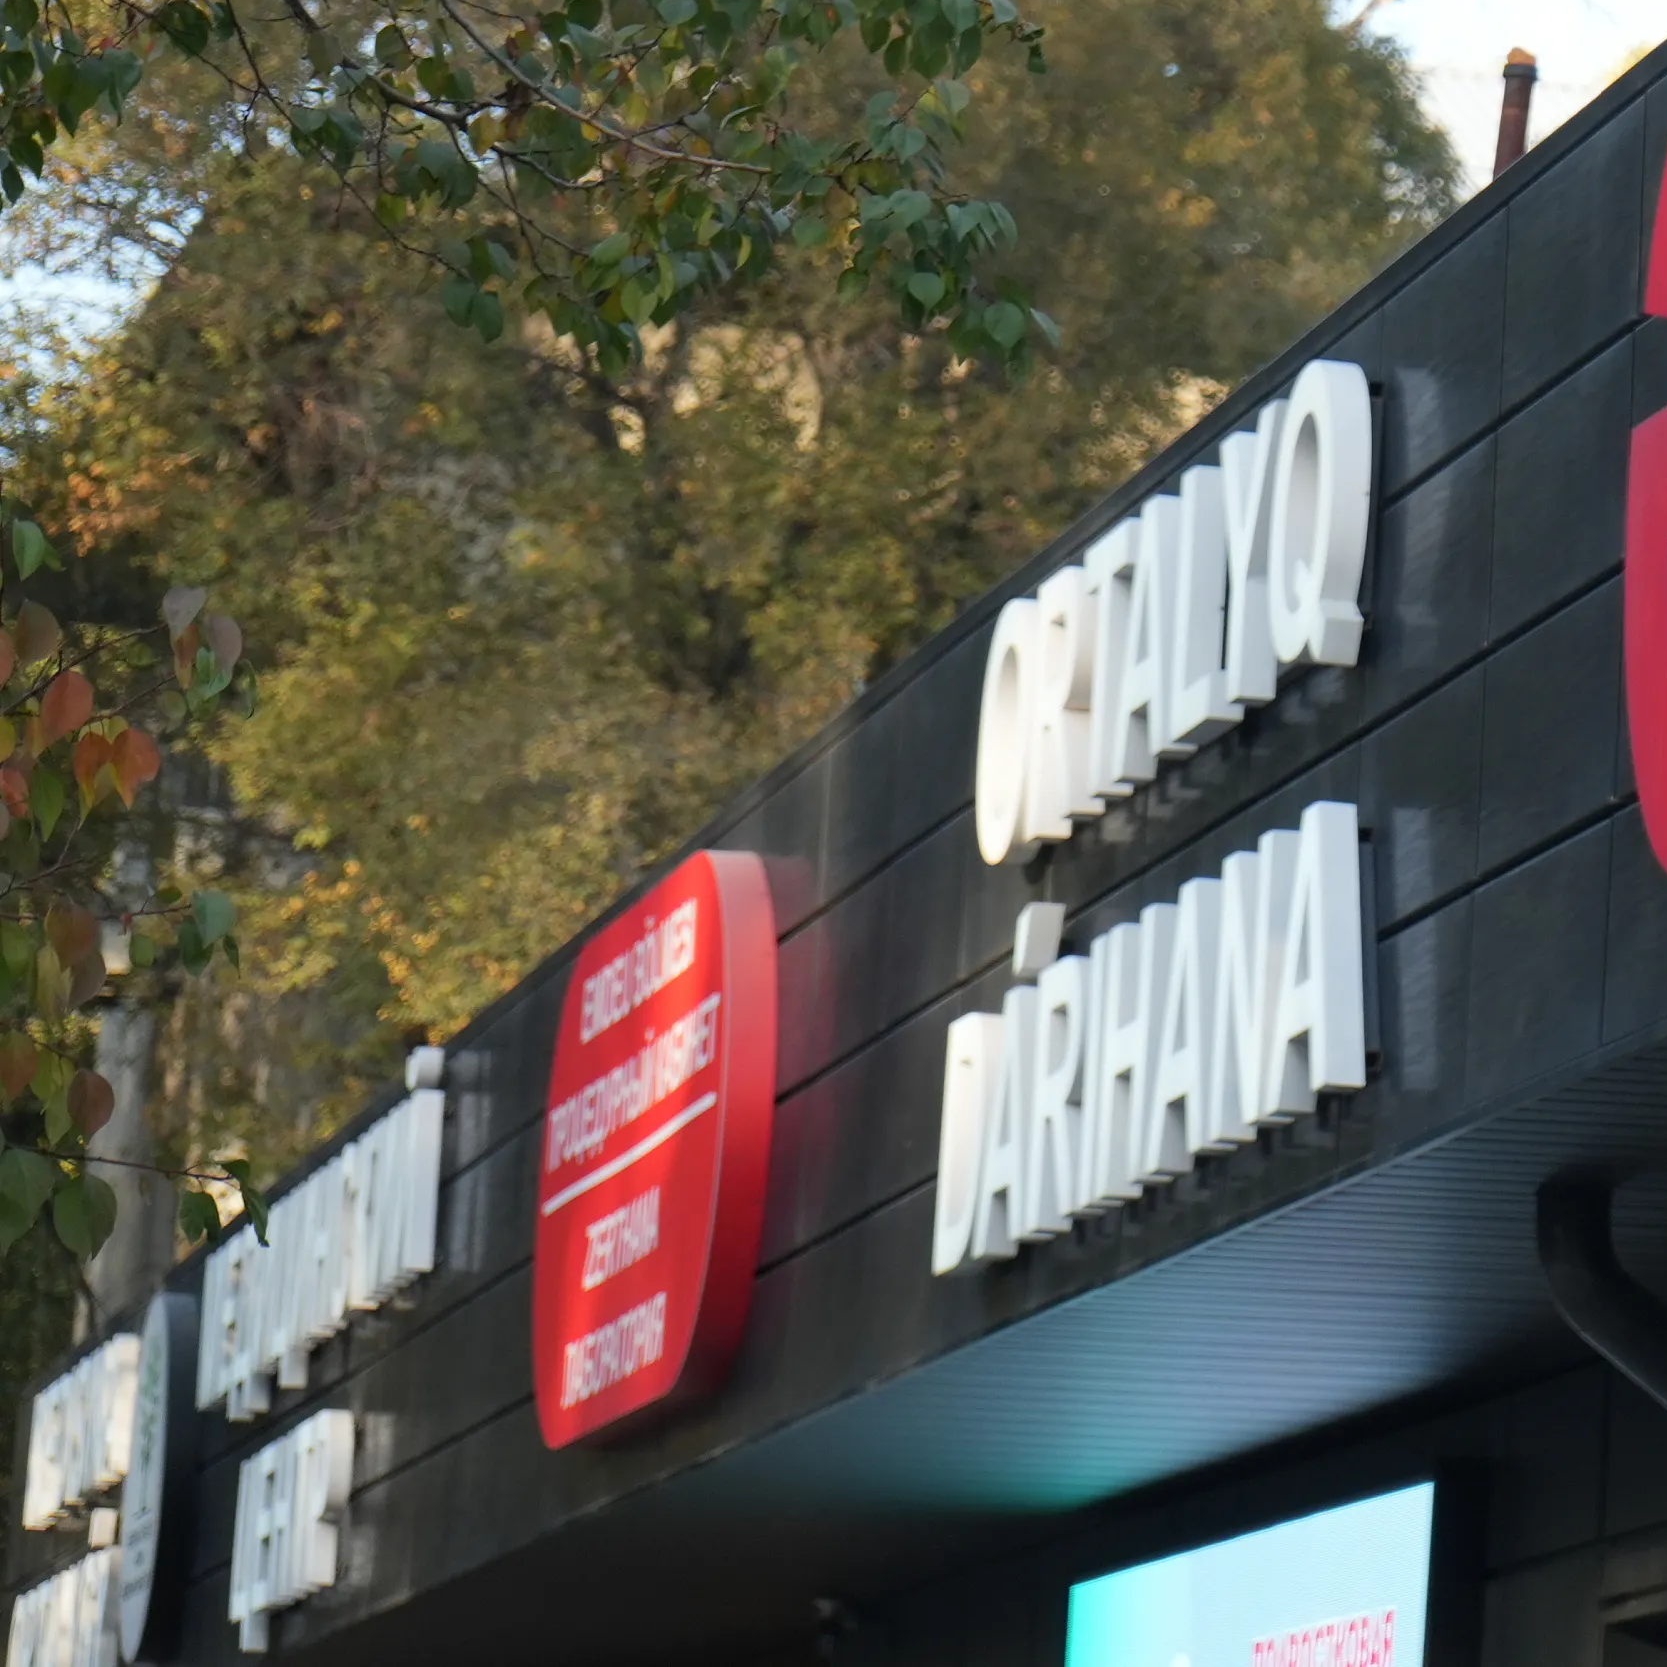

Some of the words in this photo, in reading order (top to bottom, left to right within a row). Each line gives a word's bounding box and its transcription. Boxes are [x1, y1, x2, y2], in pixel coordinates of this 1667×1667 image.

[974, 359, 1374, 868] ORTALYQ
[544, 1026, 656, 1174] ПРОЦЕДУРНЫЙ
[654, 990, 722, 1104] КАБИНЕТ
[581, 1184, 661, 1292] ZERTHANA
[560, 1290, 667, 1410] ЛАБОРАТОРИЯ
